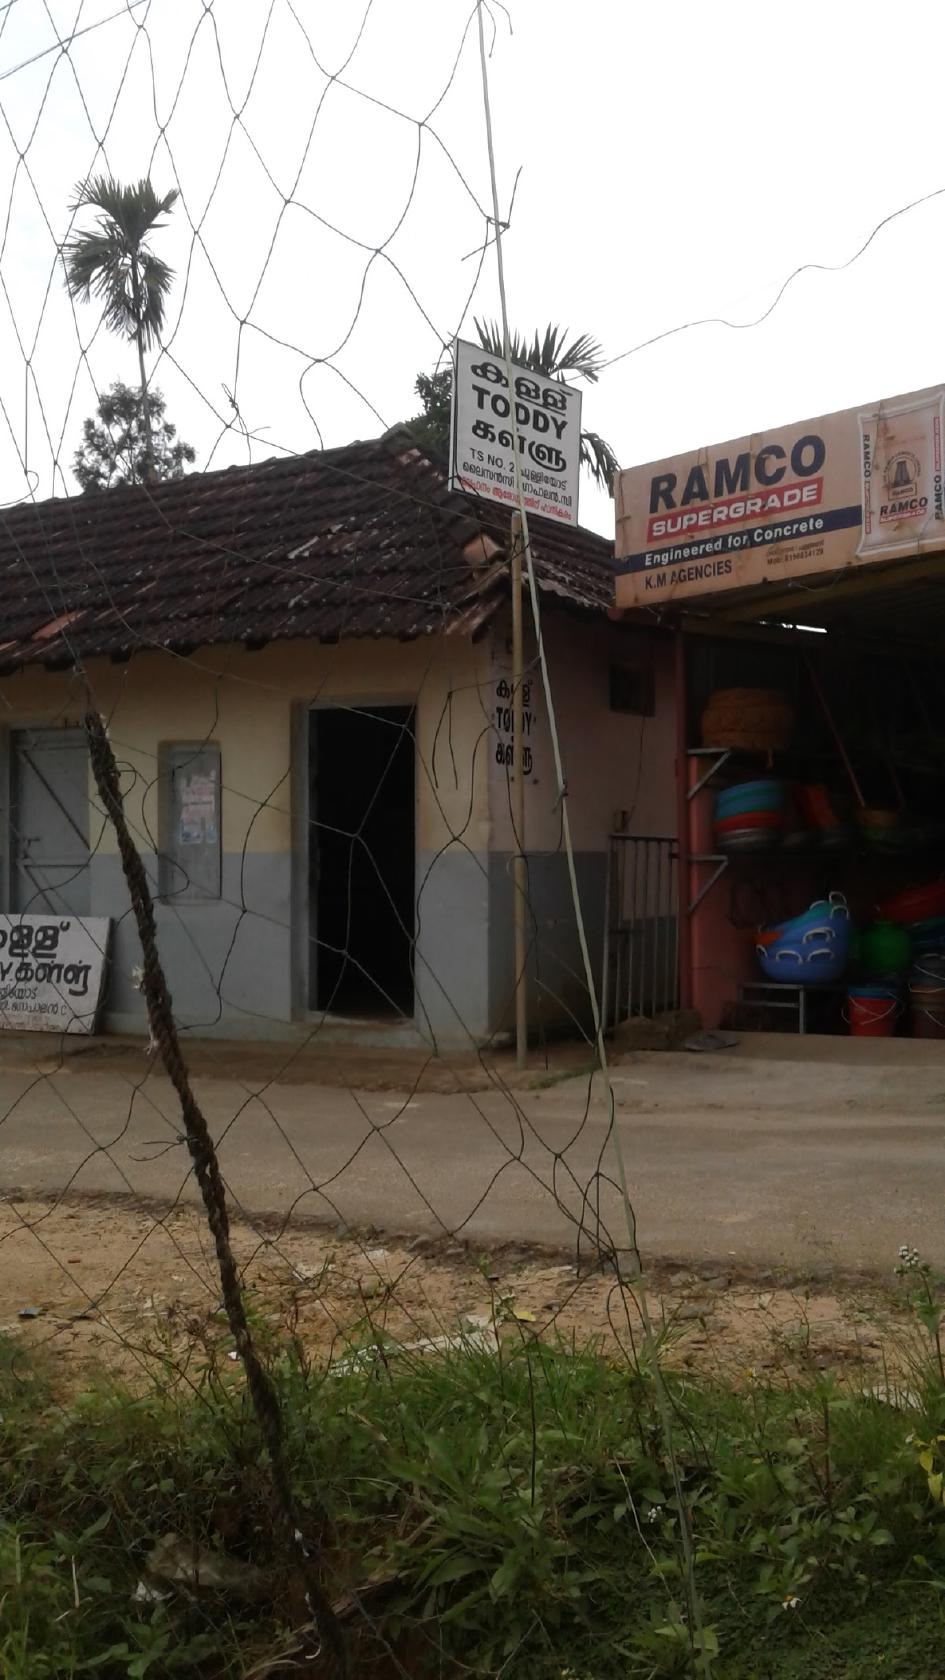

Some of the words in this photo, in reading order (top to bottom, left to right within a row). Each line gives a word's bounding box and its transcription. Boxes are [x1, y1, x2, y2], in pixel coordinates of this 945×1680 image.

[471, 384, 568, 440] TODDY
[470, 447, 484, 462] TS
[650, 435, 826, 514] RAMCO
[863, 433, 872, 478] RAMCO
[652, 483, 818, 537] SUPERGRADE
[879, 496, 929, 516] RAMCO
[645, 537, 722, 566] Engineered
[728, 534, 749, 549] for
[753, 516, 824, 542] Concrete
[670, 559, 732, 585] AGENCIES
